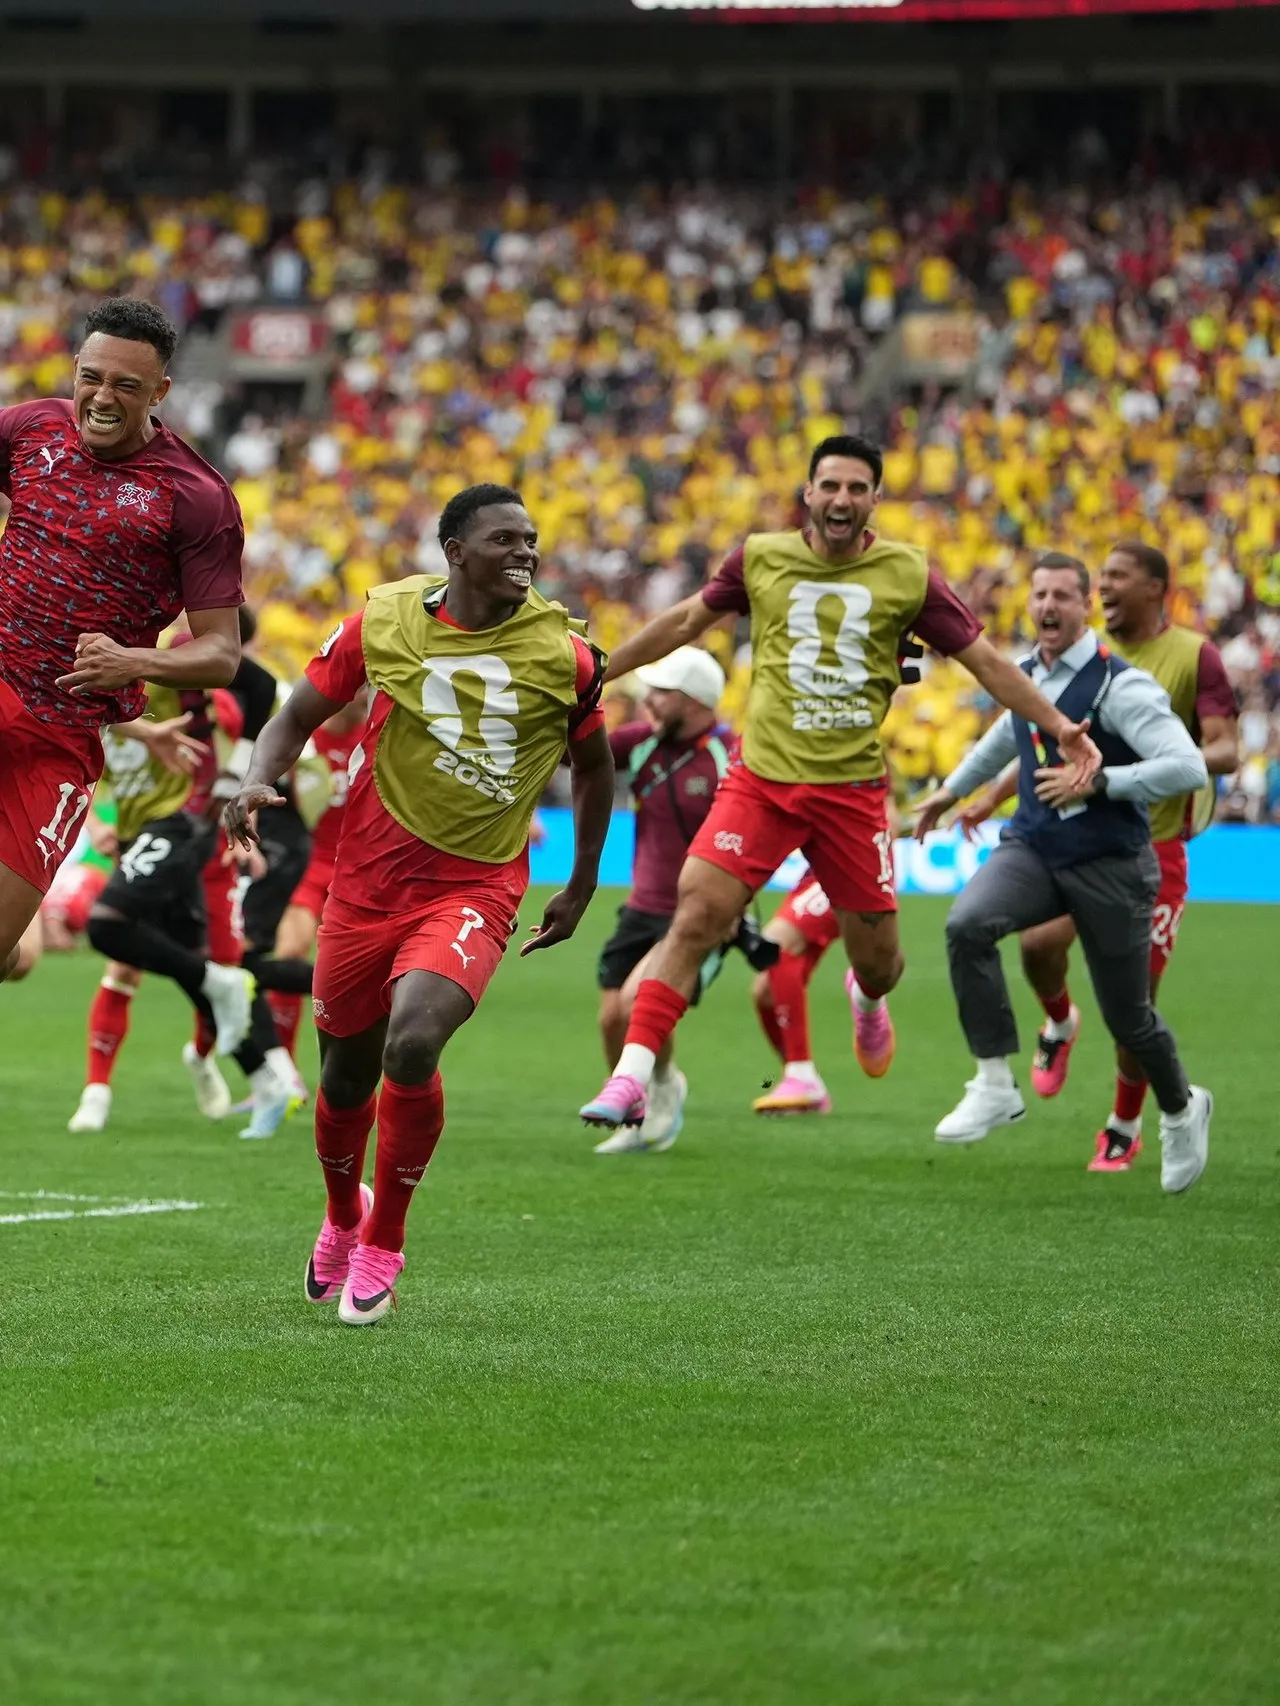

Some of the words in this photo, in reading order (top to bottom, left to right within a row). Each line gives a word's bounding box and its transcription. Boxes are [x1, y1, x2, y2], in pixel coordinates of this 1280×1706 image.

[792, 709, 873, 731] 2026
[432, 750, 516, 805] 2026
[39, 782, 89, 852] 11
[120, 832, 172, 876] 12
